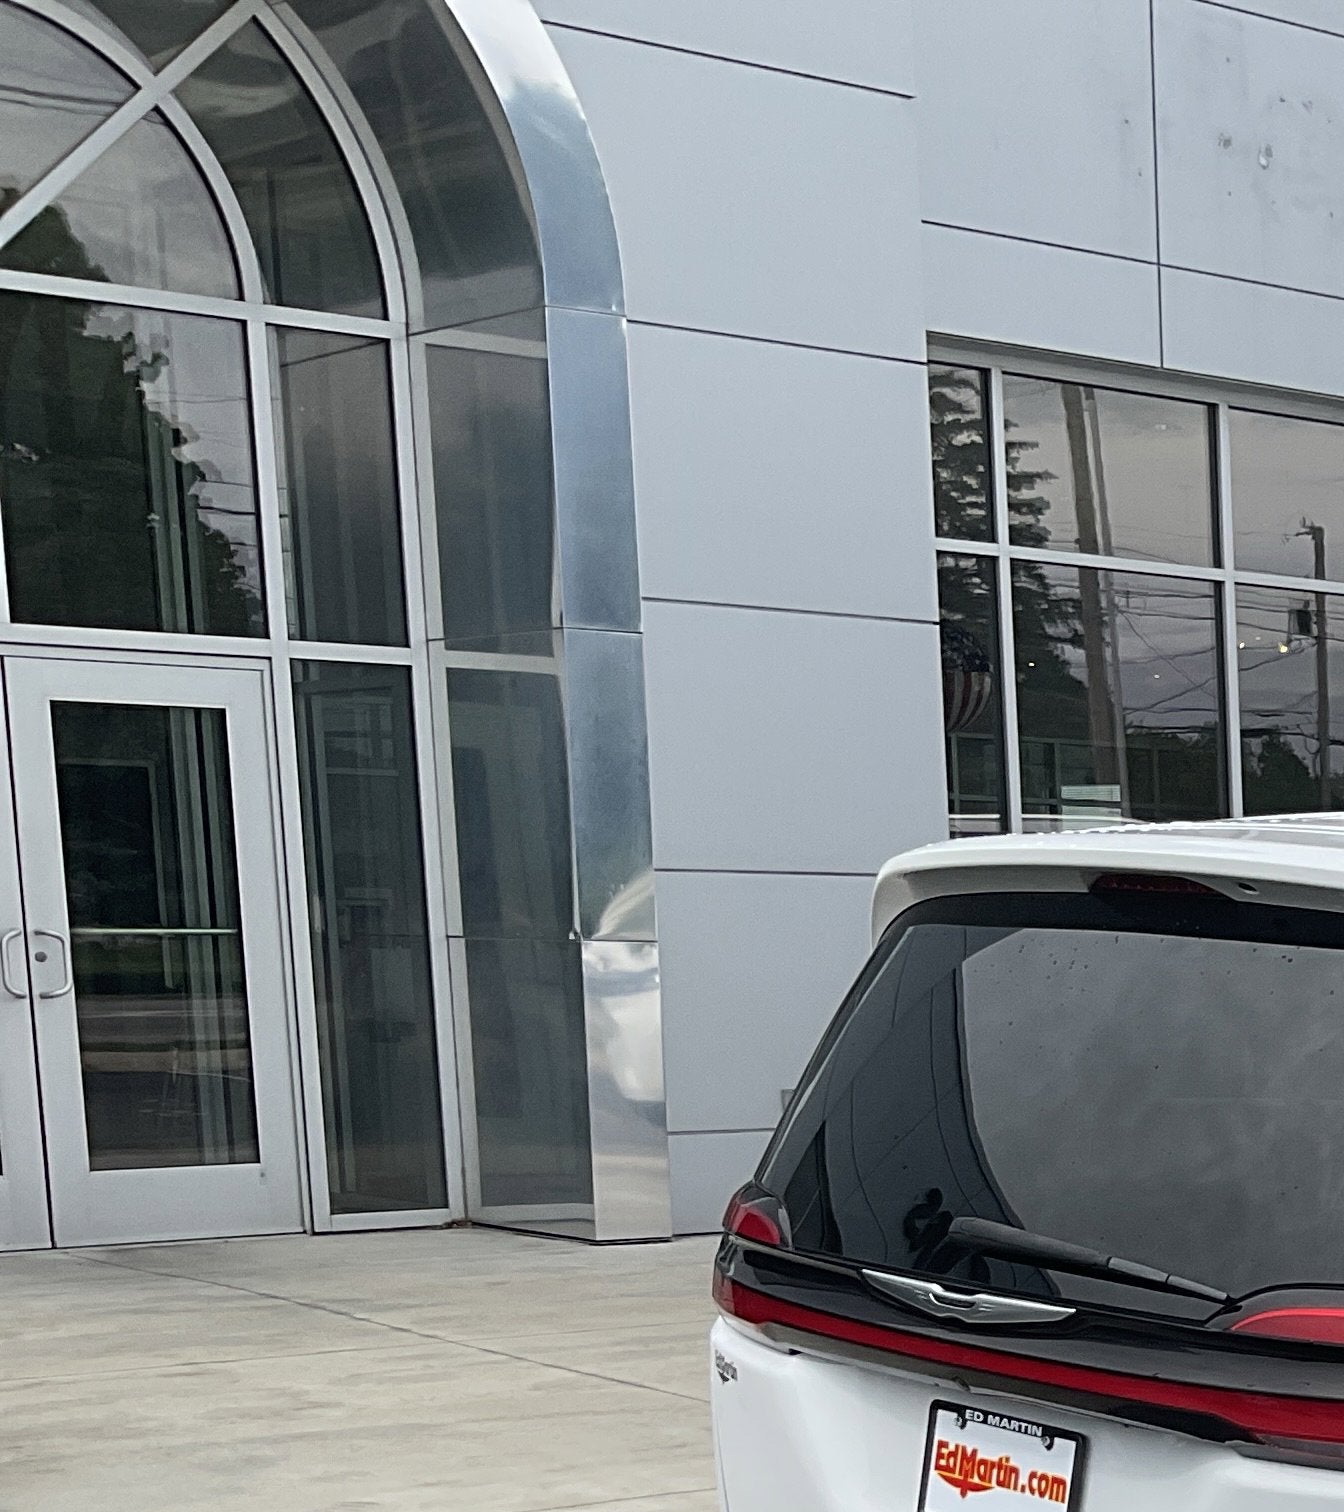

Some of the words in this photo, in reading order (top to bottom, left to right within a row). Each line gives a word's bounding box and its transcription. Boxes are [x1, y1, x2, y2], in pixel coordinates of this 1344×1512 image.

[965, 1409, 984, 1423] ED
[987, 1415, 1043, 1436] MARTIN
[934, 1439, 1067, 1504] EdMartin.com
